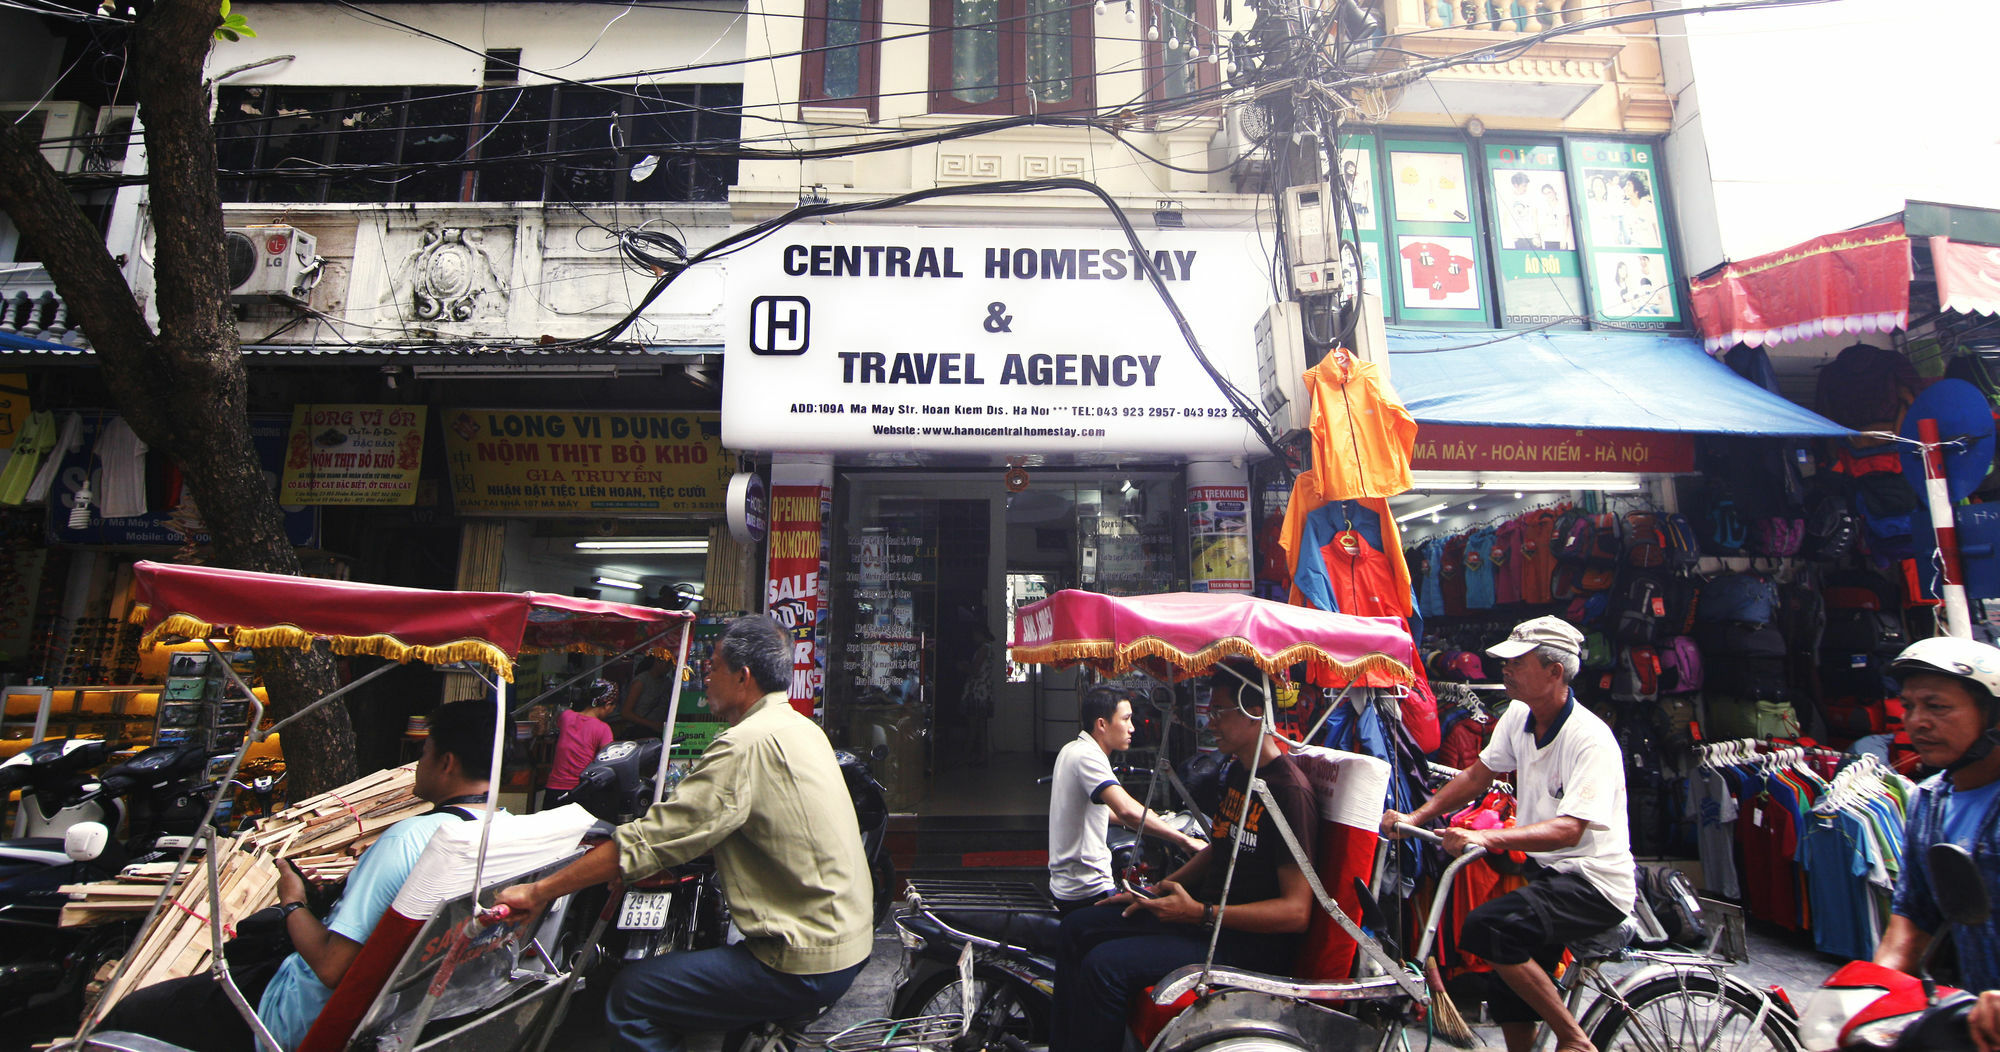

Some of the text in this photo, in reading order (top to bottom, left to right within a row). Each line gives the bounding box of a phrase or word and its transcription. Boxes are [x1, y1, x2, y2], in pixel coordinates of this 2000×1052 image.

[1499, 145, 1649, 165] Oliver Couple
[266, 257, 282, 267] LG
[784, 245, 1197, 281] CENTRAL HOMESTAY
[984, 302, 1012, 333] &
[838, 352, 1161, 387] TRAVEL AGENCY
[304, 411, 353, 426] LONG
[791, 404, 844, 414] ADD:109A
[851, 404, 867, 414] Ma
[871, 405, 894, 416] May
[898, 405, 918, 414] Str.
[922, 405, 950, 415] Hoan
[1013, 406, 1028, 415] Ha
[1122, 408, 1144, 417] 923
[1183, 408, 1204, 418] 043
[1207, 408, 1228, 418] 923
[489, 415, 690, 439] LONG VI DUNG
[478, 438, 707, 467] NỘM THỊT BÒ KHÔ
[1413, 439, 1437, 459] MÃ
[1442, 441, 1478, 460] MÂY
[1492, 440, 1538, 461] HOÀN
[1542, 439, 1581, 462] KIẾM
[1594, 441, 1617, 462] HÀ
[1622, 442, 1649, 466] NỘI
[335, 453, 357, 471] THỊT
[526, 465, 662, 483] GIA TRUYỀN
[488, 484, 521, 498] NHẬN
[525, 484, 546, 499] ĐẶT
[550, 484, 575, 499] TIỆC
[580, 484, 605, 498] LIÊN
[650, 486, 678, 500] TIỆC
[1204, 489, 1245, 498] TREKKING
[126, 532, 163, 542] Mobile:
[770, 530, 820, 559] PROMOTION
[768, 572, 818, 604] SALE
[629, 894, 666, 909] 29-K2
[625, 911, 660, 927] 8336
